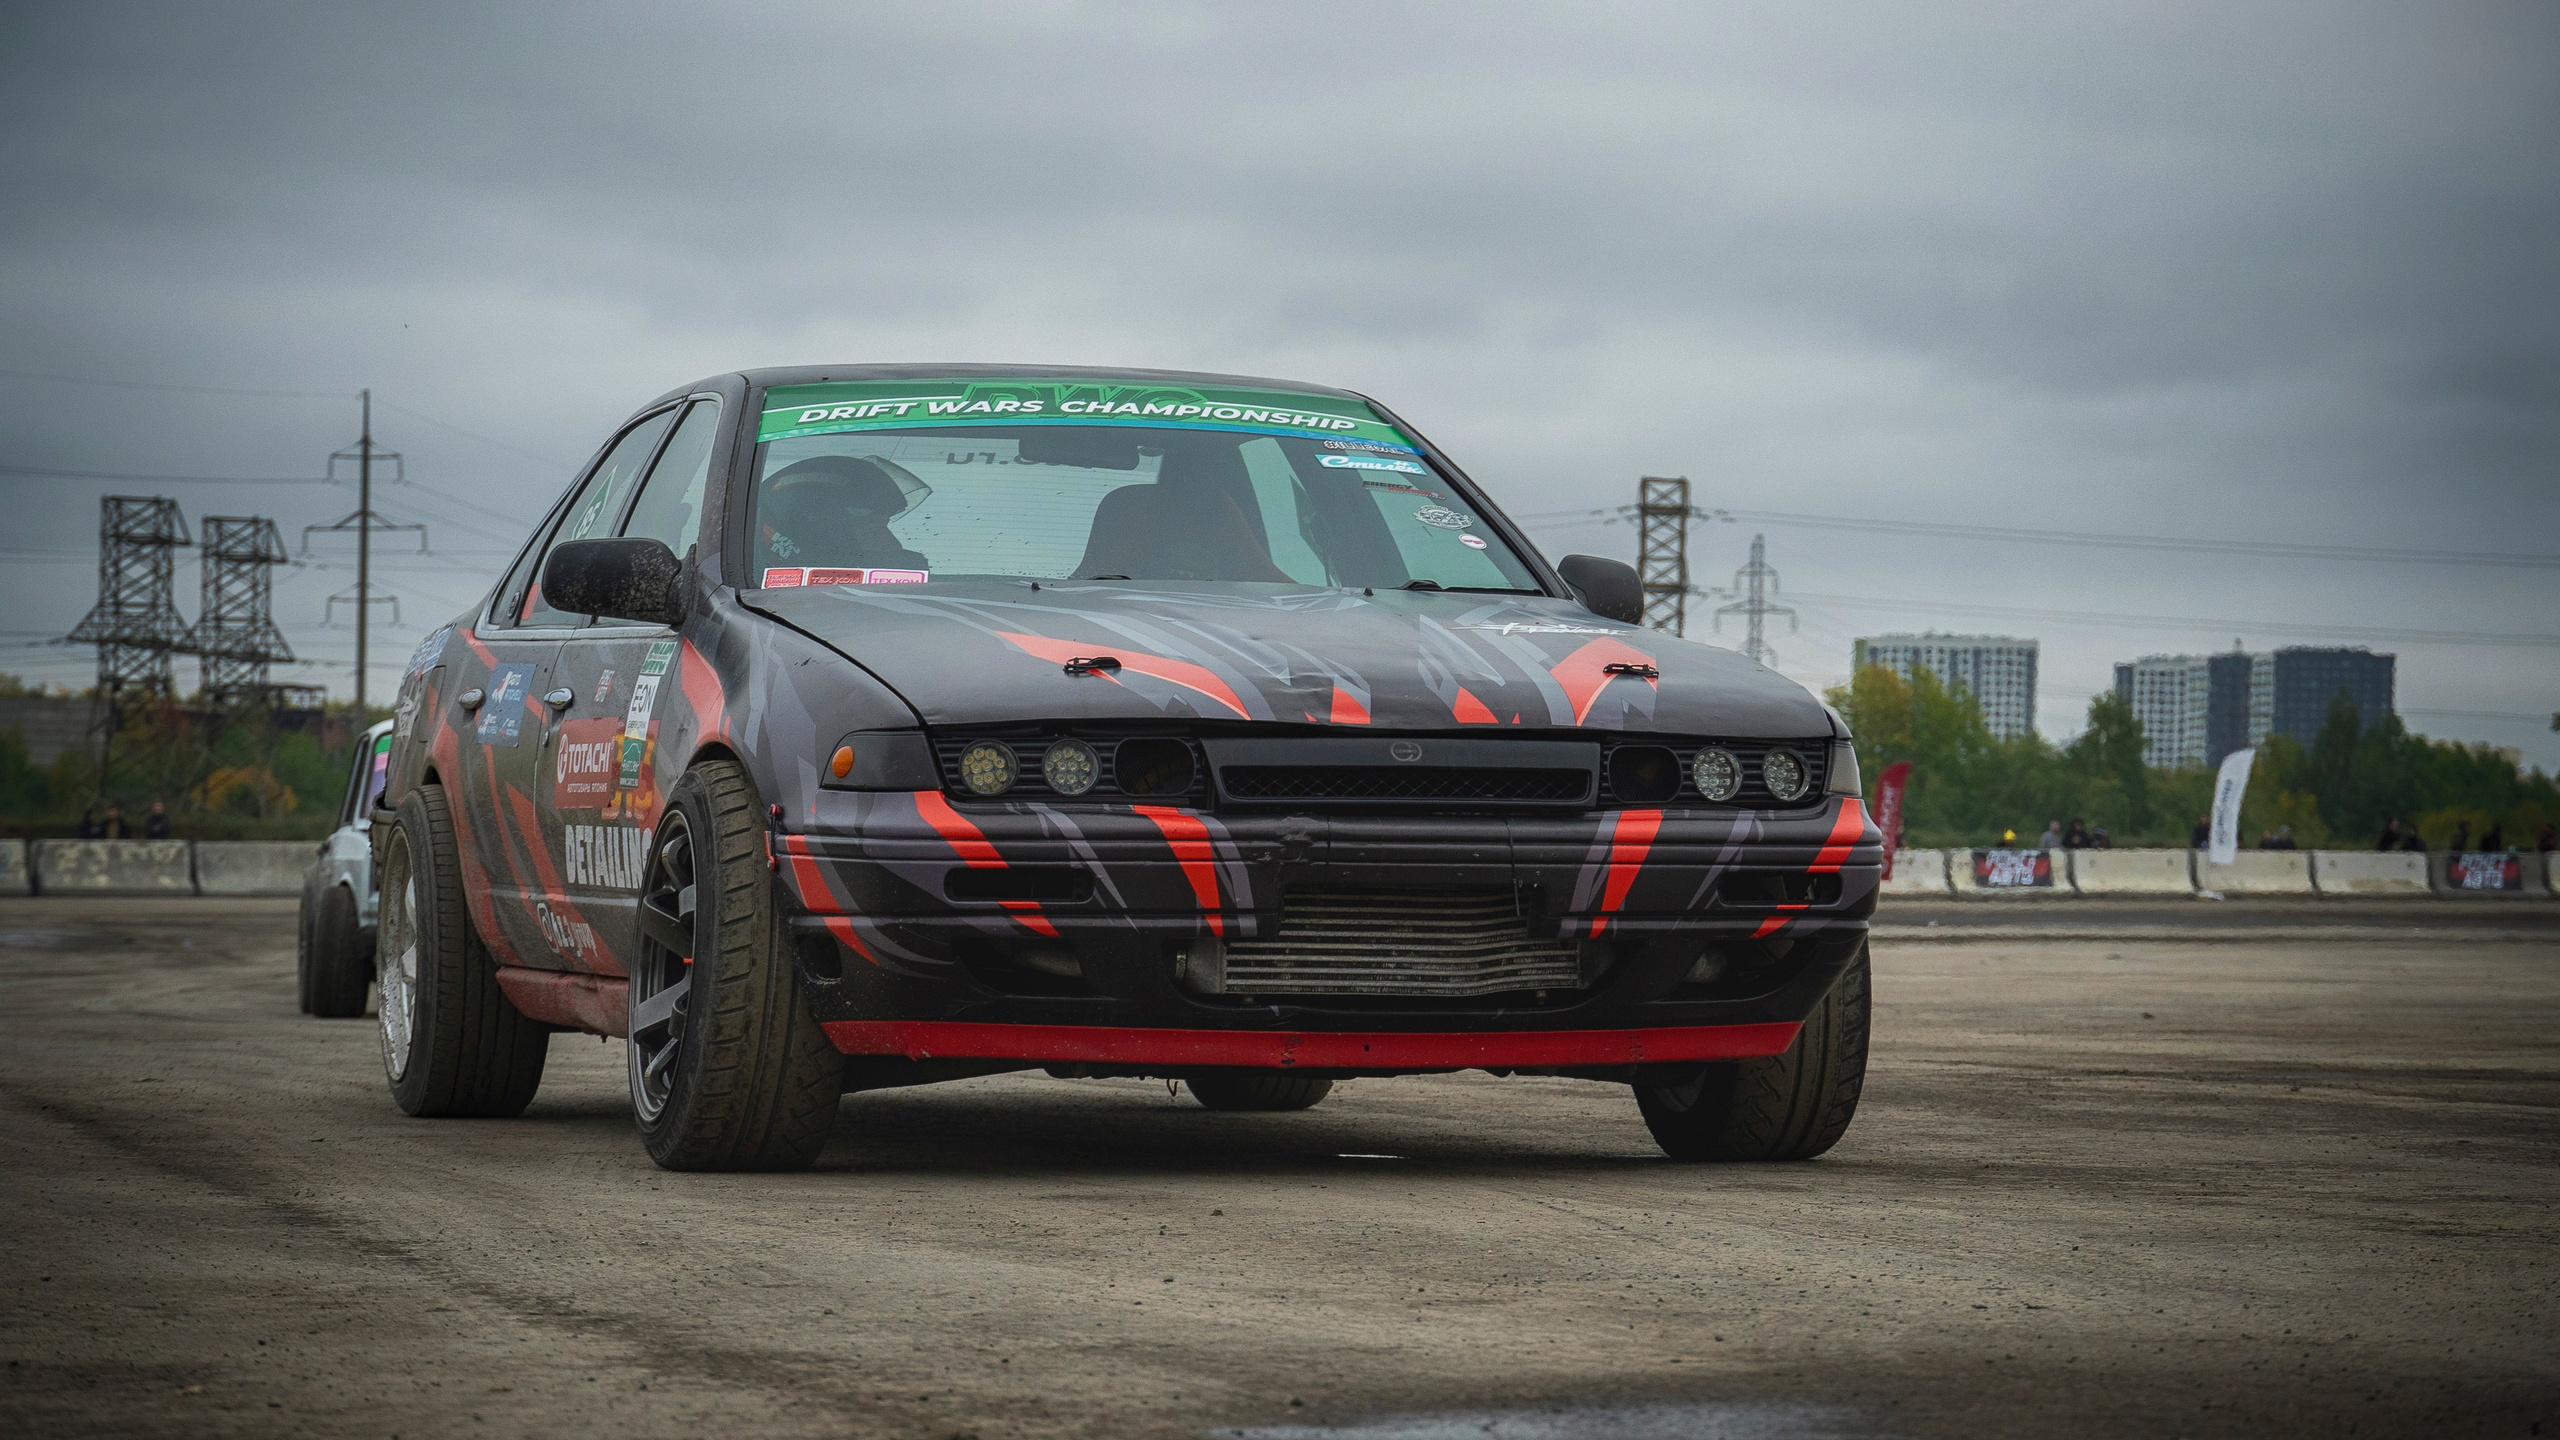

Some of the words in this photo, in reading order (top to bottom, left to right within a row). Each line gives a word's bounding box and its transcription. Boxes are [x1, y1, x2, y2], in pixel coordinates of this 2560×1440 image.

[798, 402, 917, 423] DRIFT
[927, 400, 1045, 414] WARS
[1060, 400, 1356, 430] CHAMPIONSHIP
[568, 742, 612, 773] TOTACHI
